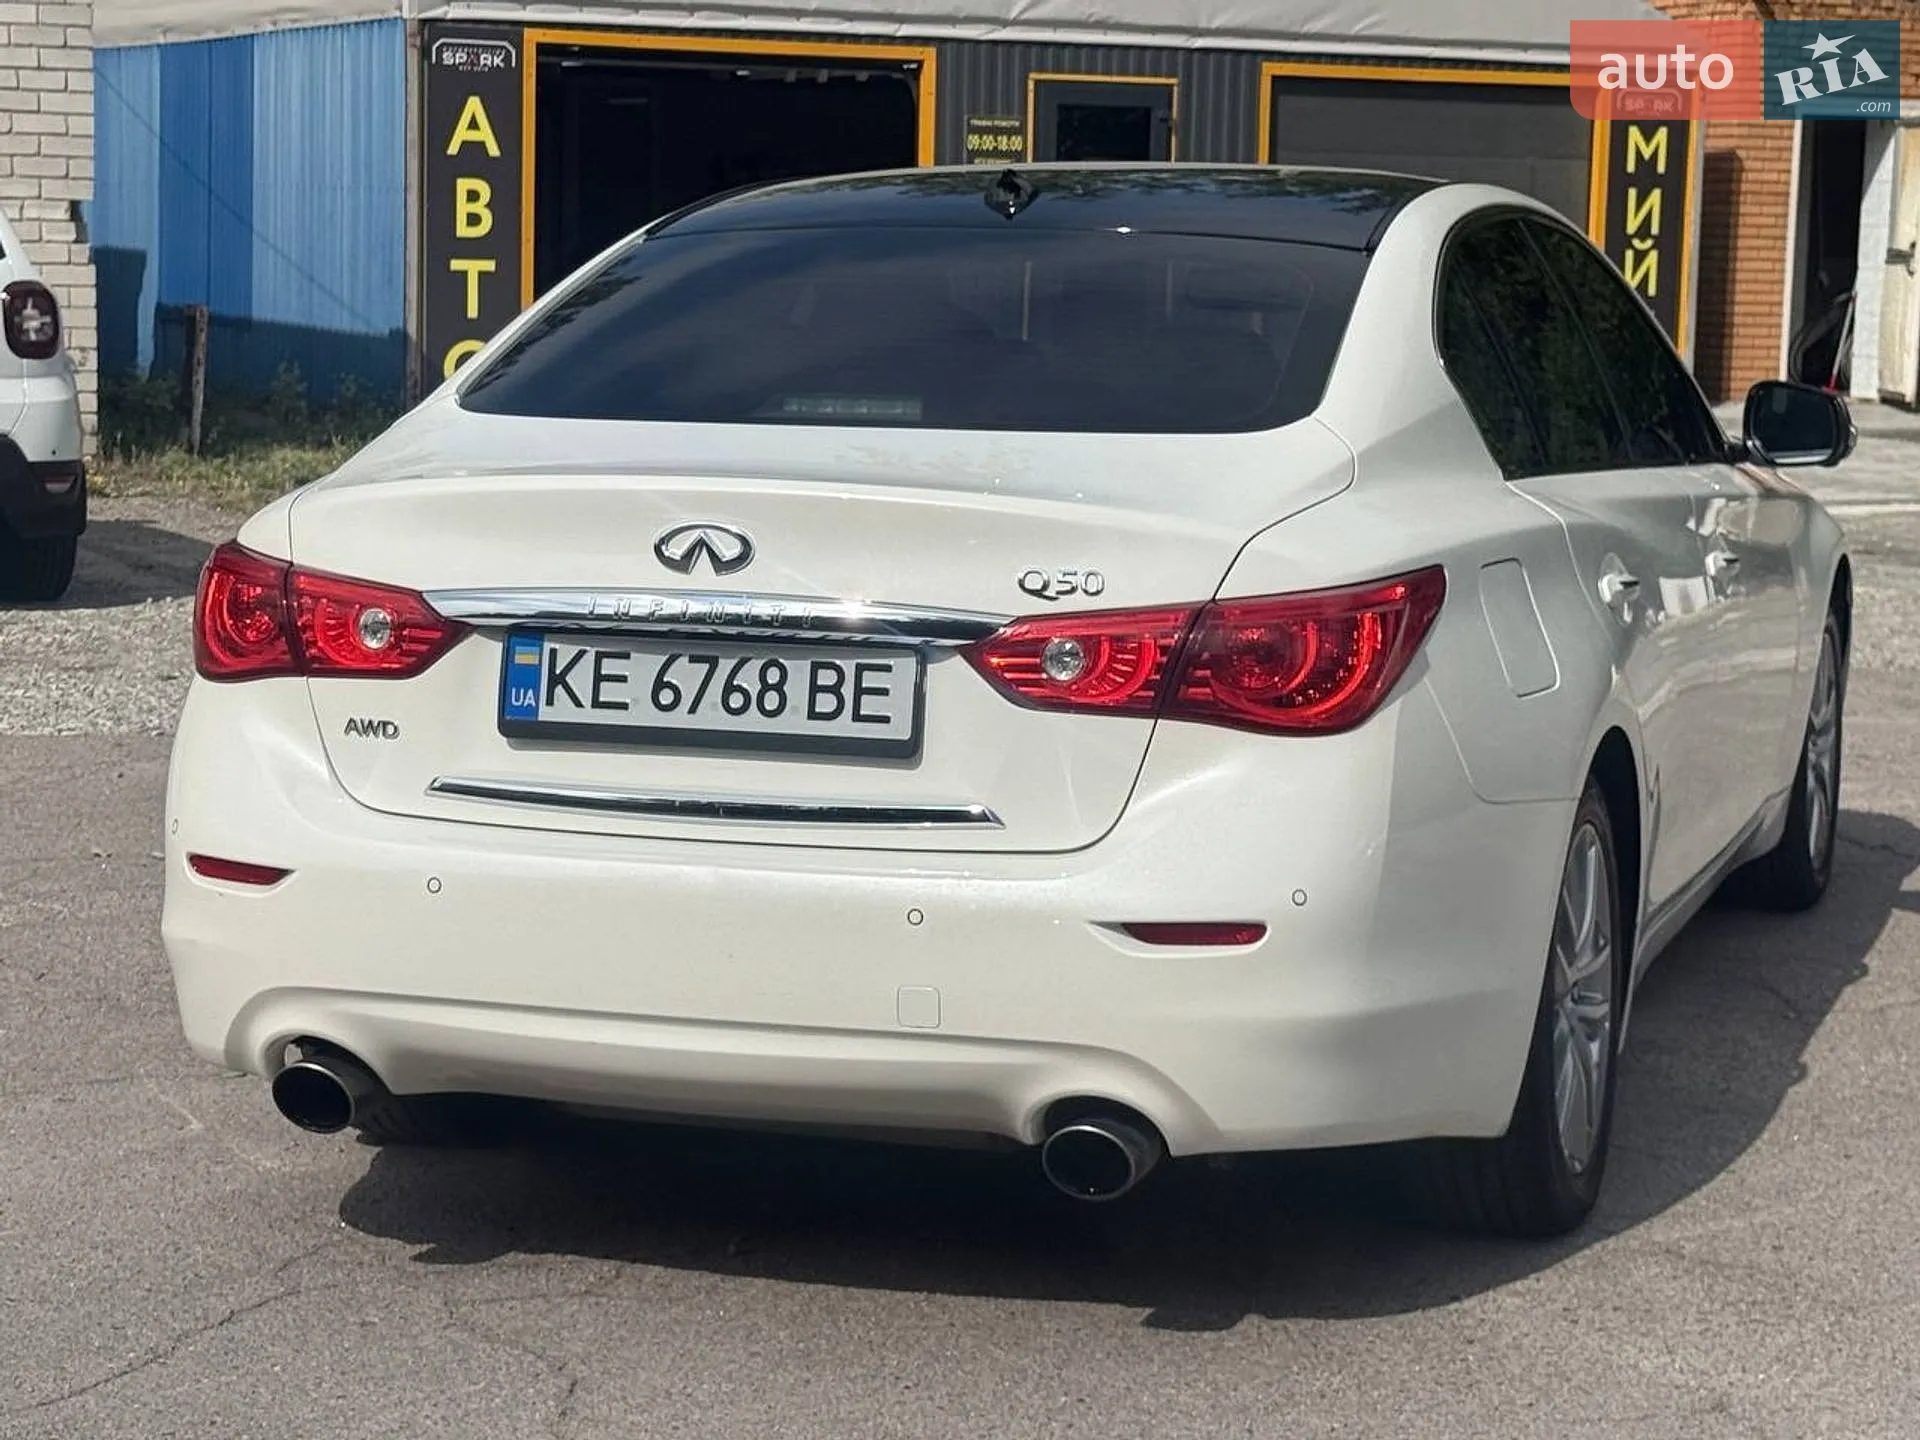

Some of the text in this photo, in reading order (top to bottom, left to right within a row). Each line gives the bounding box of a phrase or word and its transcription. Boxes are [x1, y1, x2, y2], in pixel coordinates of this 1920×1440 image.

[967, 134, 1023, 151] 09:00-18:00
[1624, 126, 1668, 297] МИЙ
[1018, 569, 1105, 601] Q50
[587, 594, 813, 628] INFINITI
[511, 687, 536, 706] UA
[544, 647, 893, 724] KE 6768 BE
[344, 717, 400, 739] AWD
